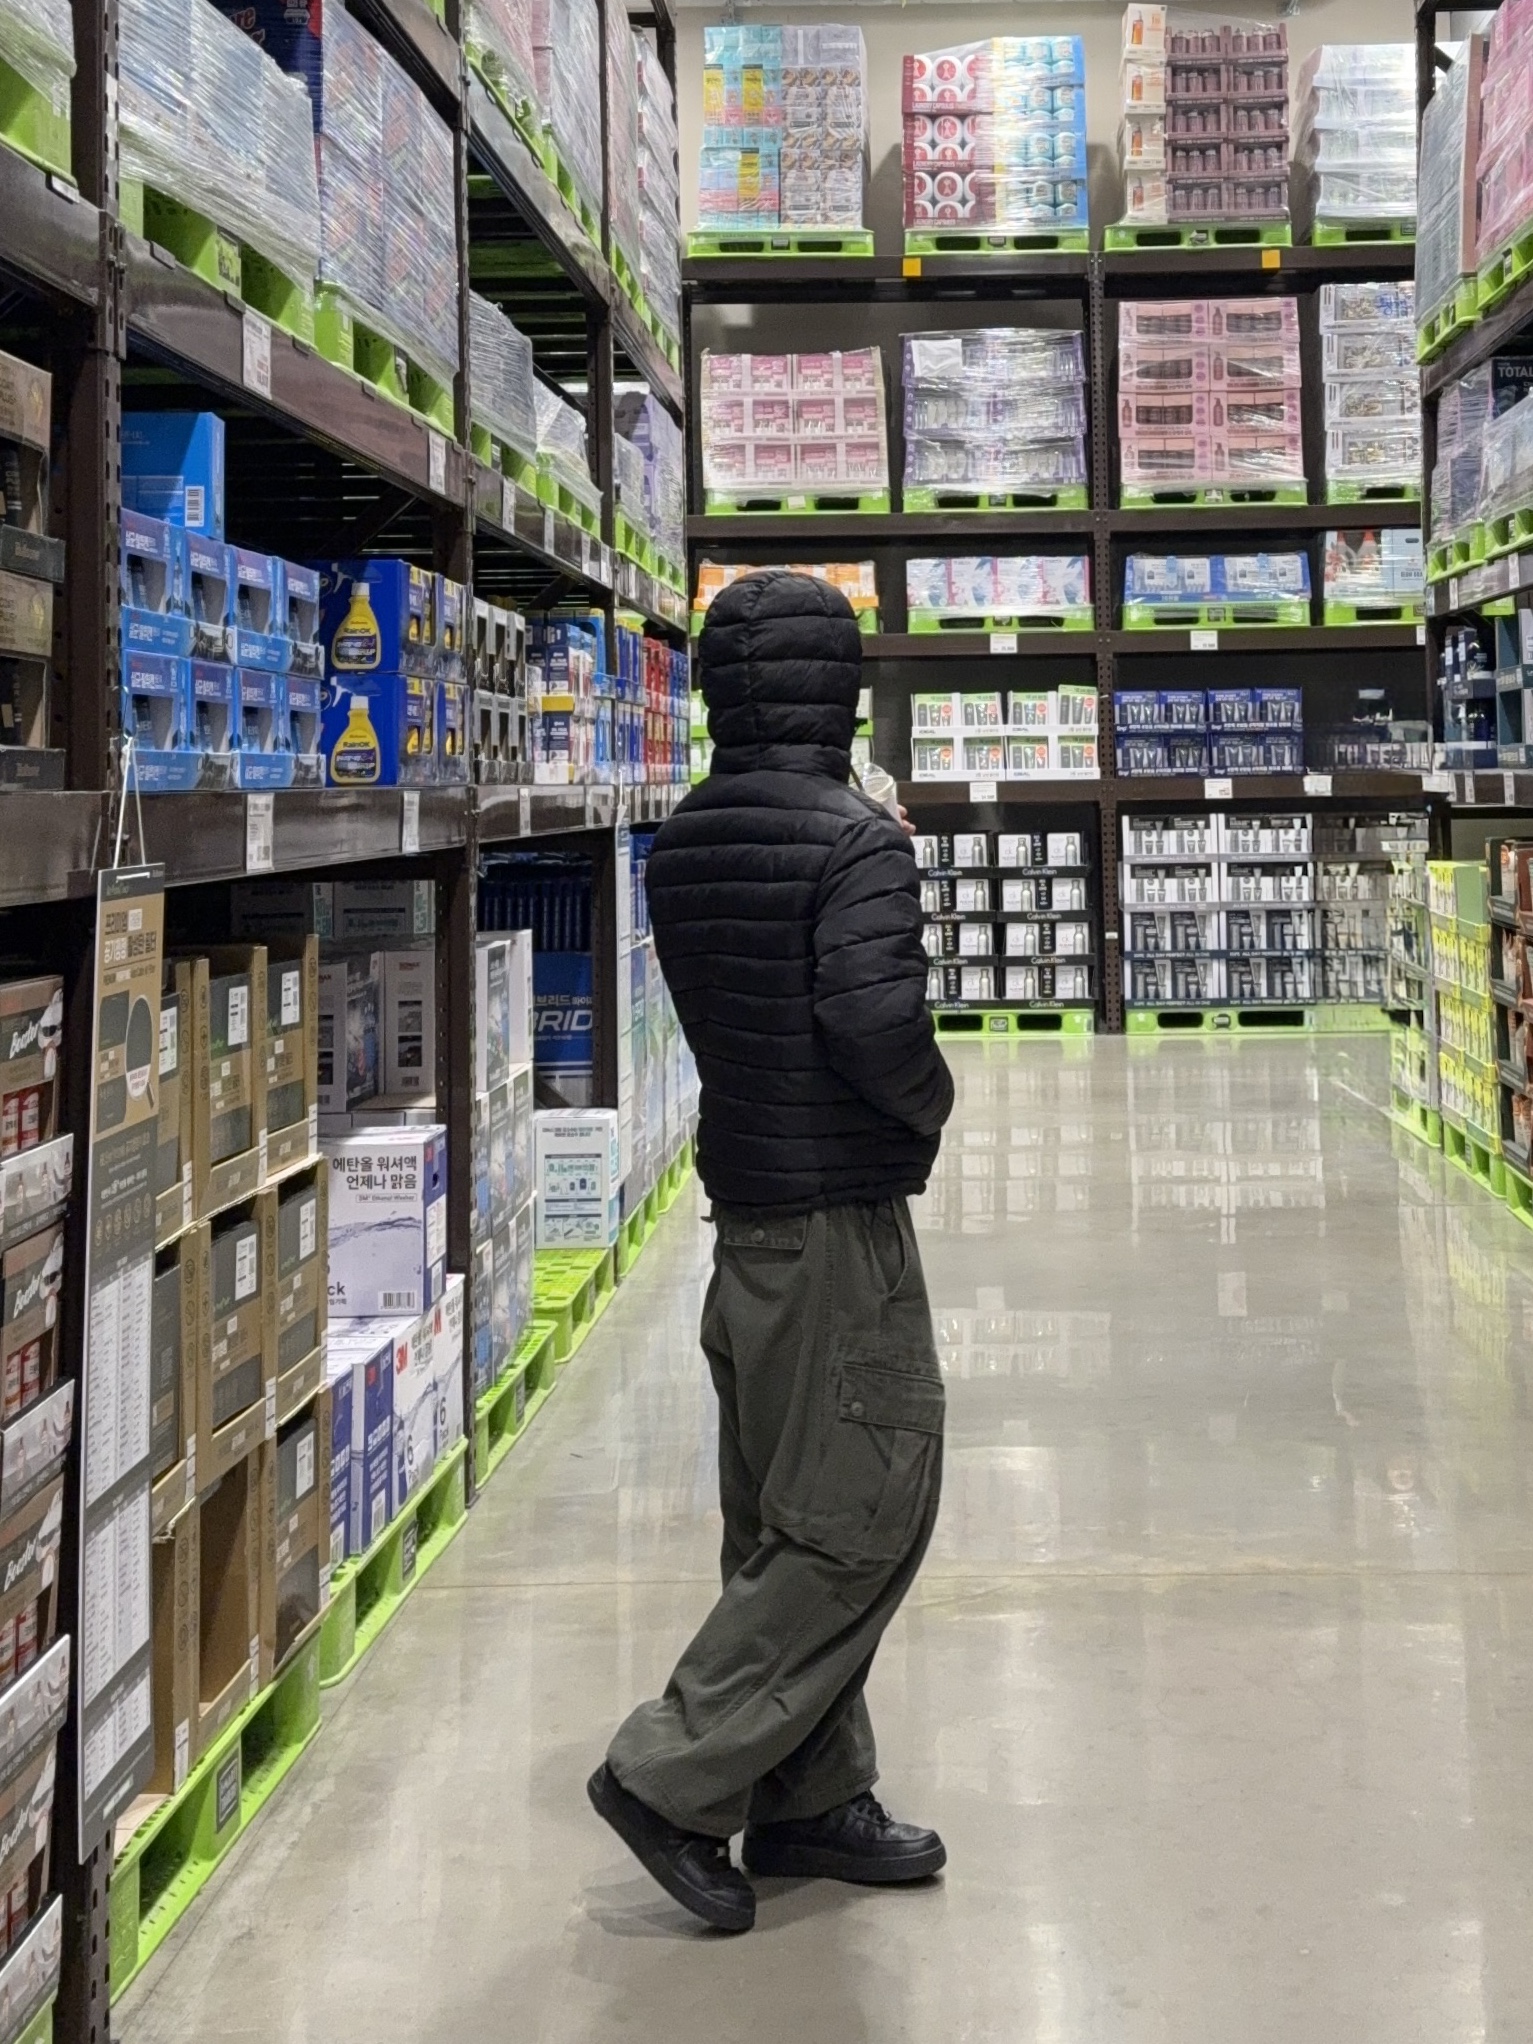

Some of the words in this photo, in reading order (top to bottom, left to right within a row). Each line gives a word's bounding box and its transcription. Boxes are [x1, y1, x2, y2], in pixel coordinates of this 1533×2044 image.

[928, 869, 948, 877] Calvin
[949, 869, 963, 877] Klein
[1022, 868, 1041, 876] Calvin
[1041, 868, 1057, 876] Klein
[931, 913, 951, 921] Calvin
[951, 913, 966, 921] Klein
[1027, 912, 1046, 920] Calvin
[1046, 912, 1062, 920] Klein
[933, 958, 952, 966] Calvin
[952, 958, 968, 966] Klein
[1031, 957, 1050, 965] Calvin
[1050, 957, 1066, 965] Klein
[533, 994, 571, 1006] 브리드
[1029, 1001, 1048, 1009] Calvin
[1048, 1001, 1064, 1009] Klein
[934, 1001, 953, 1010] Calvin
[953, 1001, 969, 1010] Klein
[333, 1156, 373, 1173] 에탄올
[377, 1155, 417, 1172] 워셔액
[346, 1174, 387, 1190] 언제나
[390, 1173, 417, 1190] 맑음
[327, 1281, 346, 1296] ck
[434, 1308, 443, 1337] M
[395, 1342, 408, 1375] 3M
[439, 1396, 447, 1426] 6
[407, 1434, 414, 1466] 6
